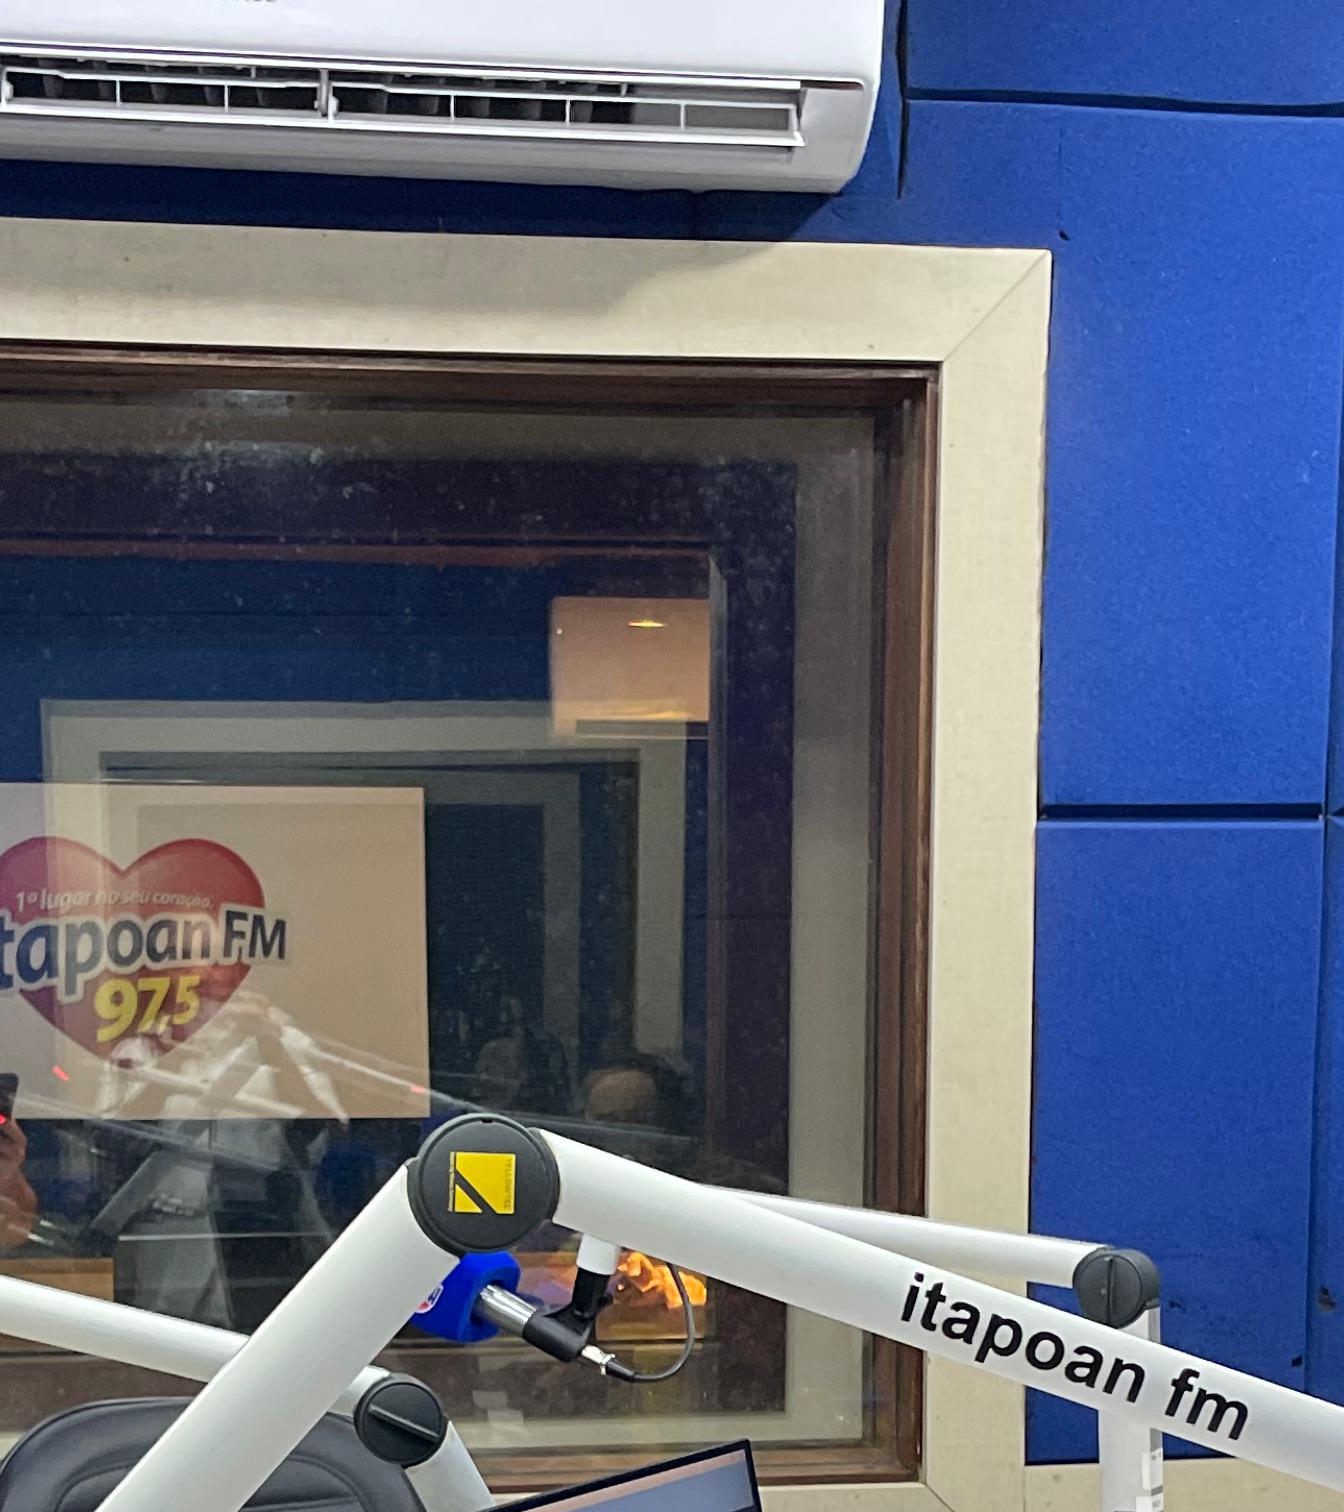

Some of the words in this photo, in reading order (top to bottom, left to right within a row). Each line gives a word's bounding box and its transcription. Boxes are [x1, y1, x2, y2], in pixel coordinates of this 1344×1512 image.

[222, 909, 288, 960] FM
[94, 974, 201, 1043] 97,5
[900, 1271, 1146, 1404] itapoan
[1163, 1368, 1250, 1441] fm
